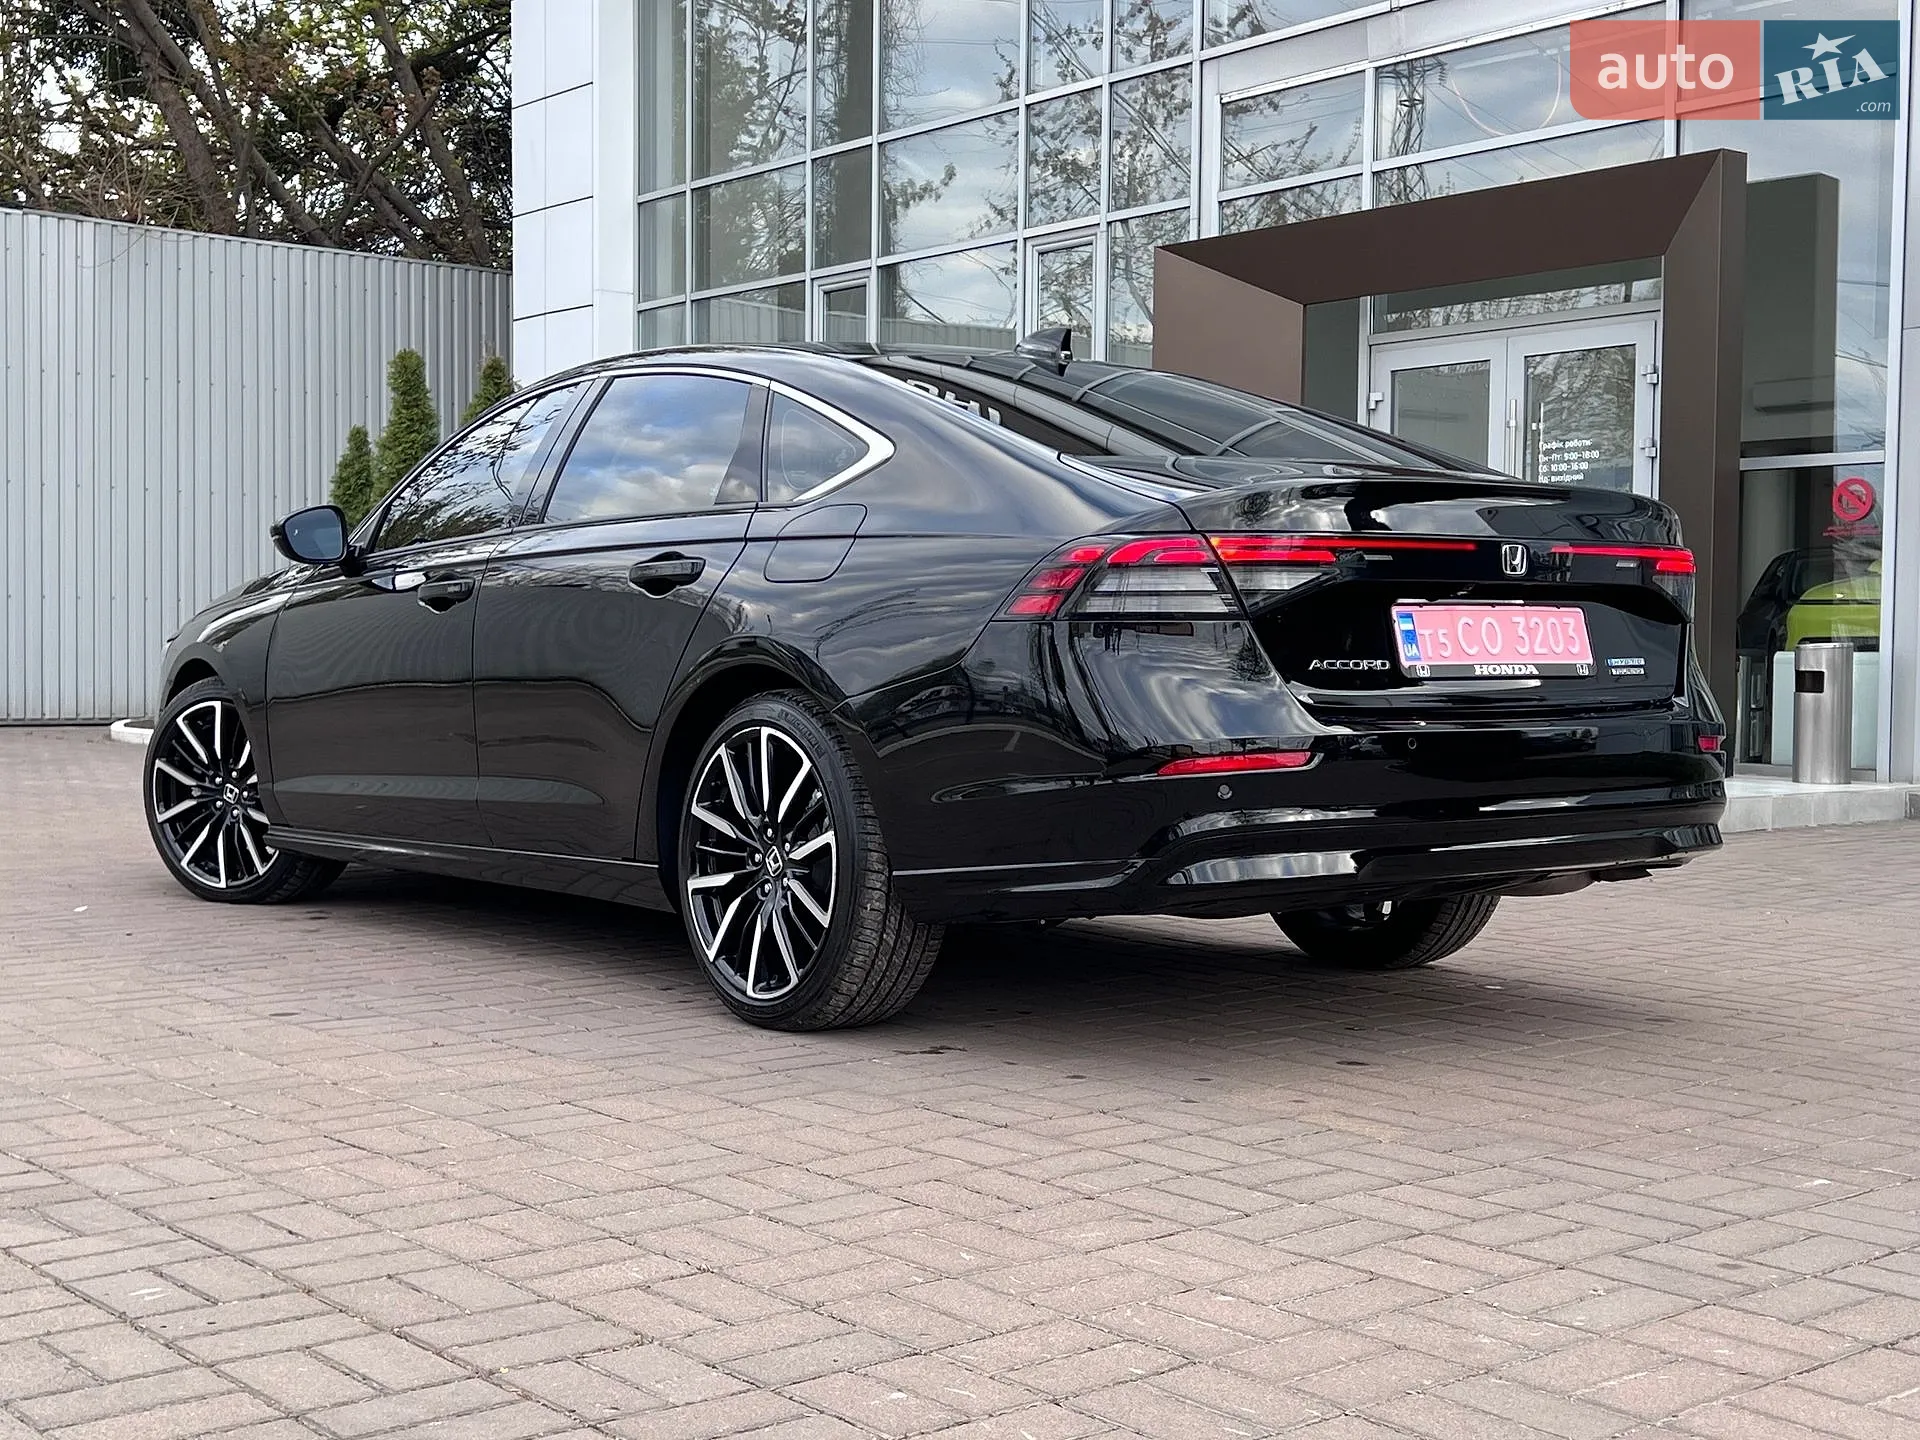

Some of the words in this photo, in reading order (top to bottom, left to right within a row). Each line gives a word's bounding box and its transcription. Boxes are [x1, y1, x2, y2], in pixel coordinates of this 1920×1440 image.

[1511, 615, 1581, 657] 3203
[1403, 643, 1420, 657] UA
[1307, 659, 1391, 671] ACCORD
[1473, 664, 1540, 676] HONDA
